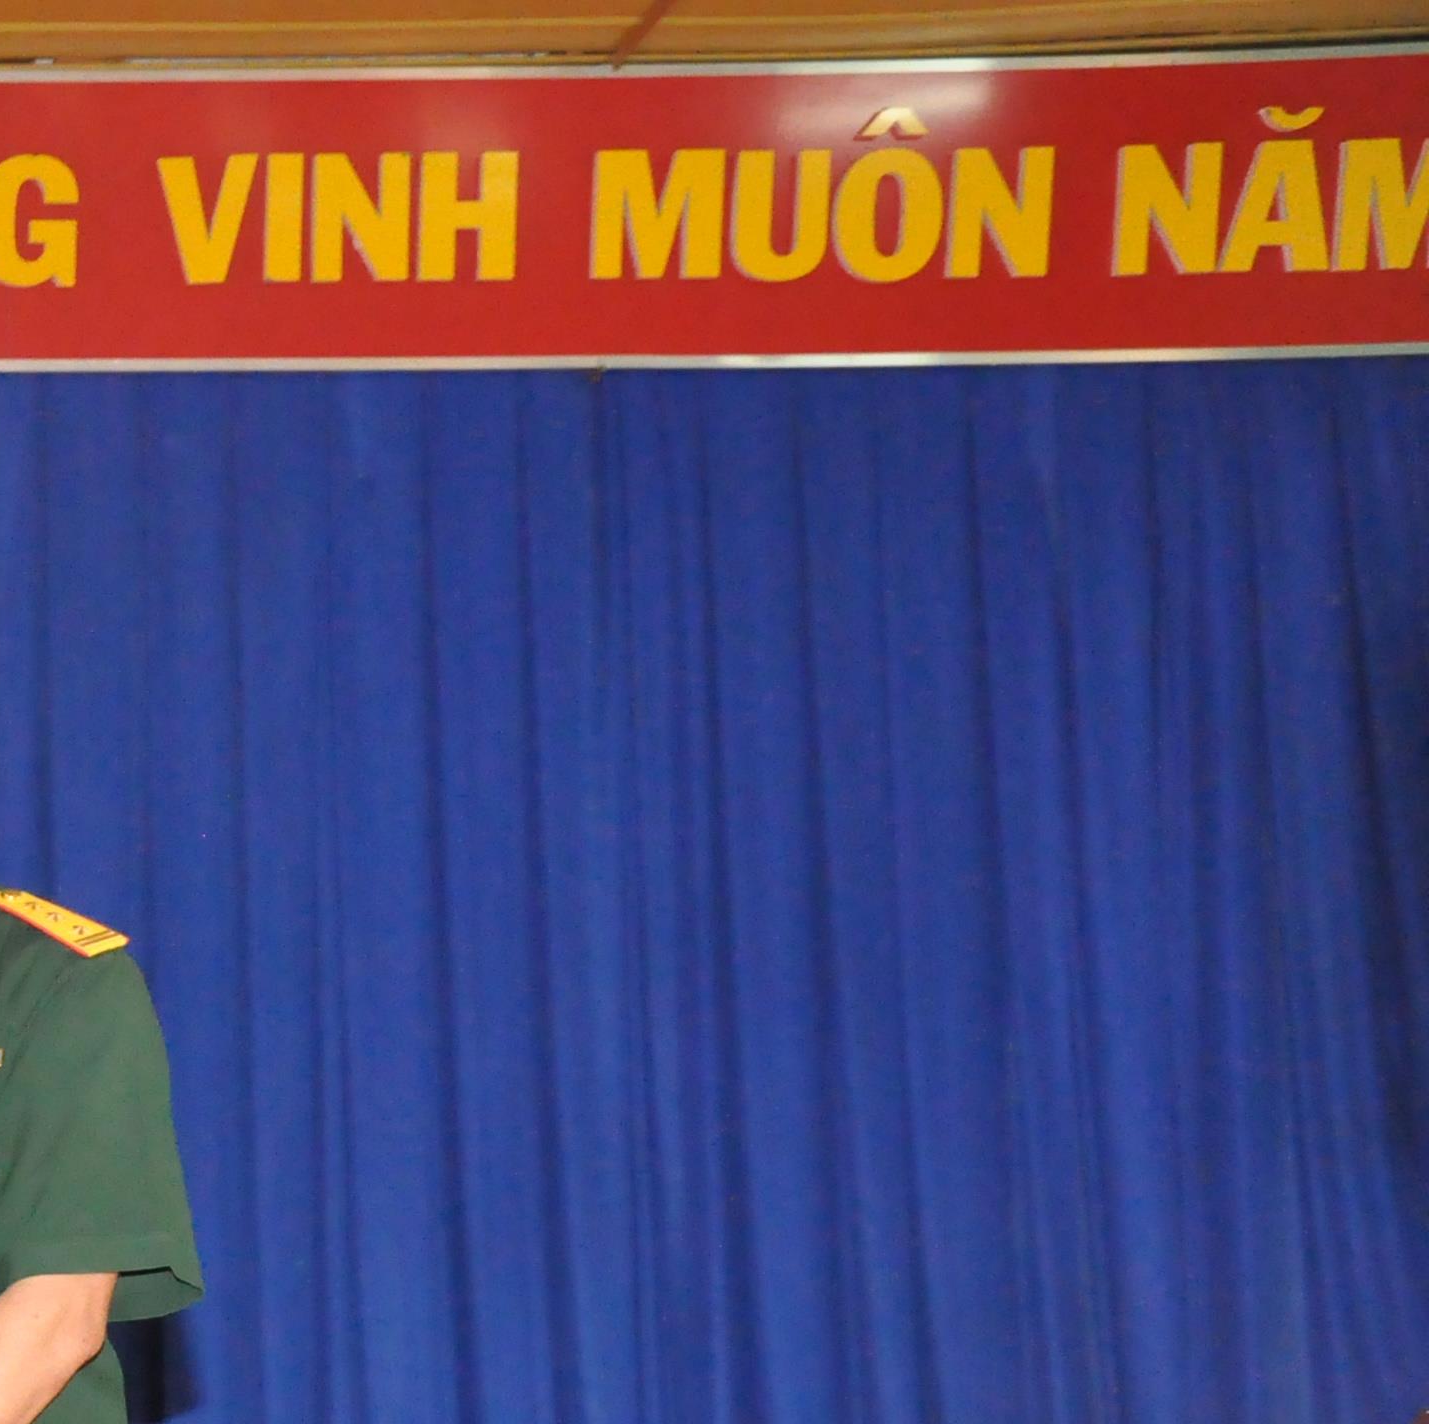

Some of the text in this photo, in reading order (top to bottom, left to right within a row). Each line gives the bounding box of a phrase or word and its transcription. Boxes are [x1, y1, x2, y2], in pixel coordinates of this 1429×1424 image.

[157, 148, 519, 286] VINH
[591, 107, 1056, 284] MUÔN
[1112, 106, 1429, 277] NĂM
